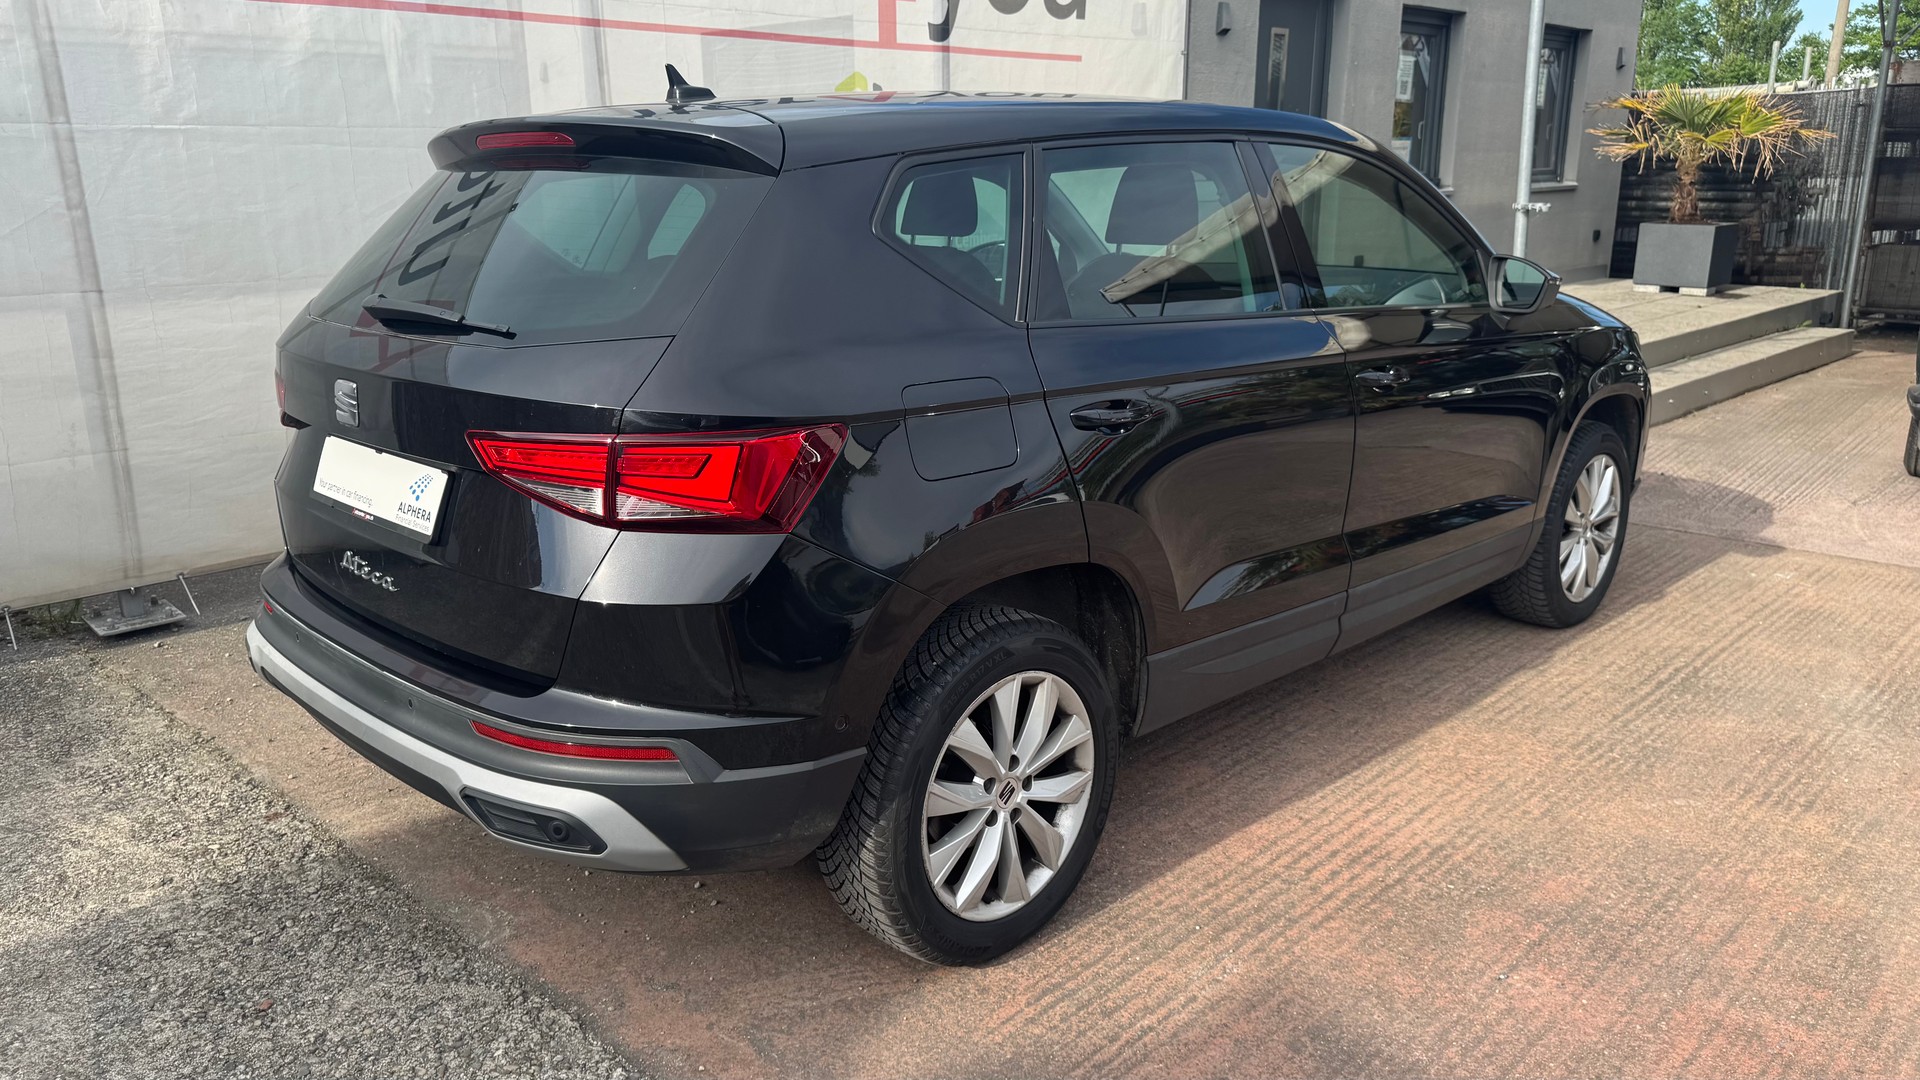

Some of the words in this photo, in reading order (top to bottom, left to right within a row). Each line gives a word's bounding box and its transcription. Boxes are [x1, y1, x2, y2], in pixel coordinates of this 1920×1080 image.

[395, 513, 412, 526] Financial
[412, 519, 430, 533] Services
[397, 501, 432, 524] ALPHERA
[339, 550, 401, 592] Ateca
